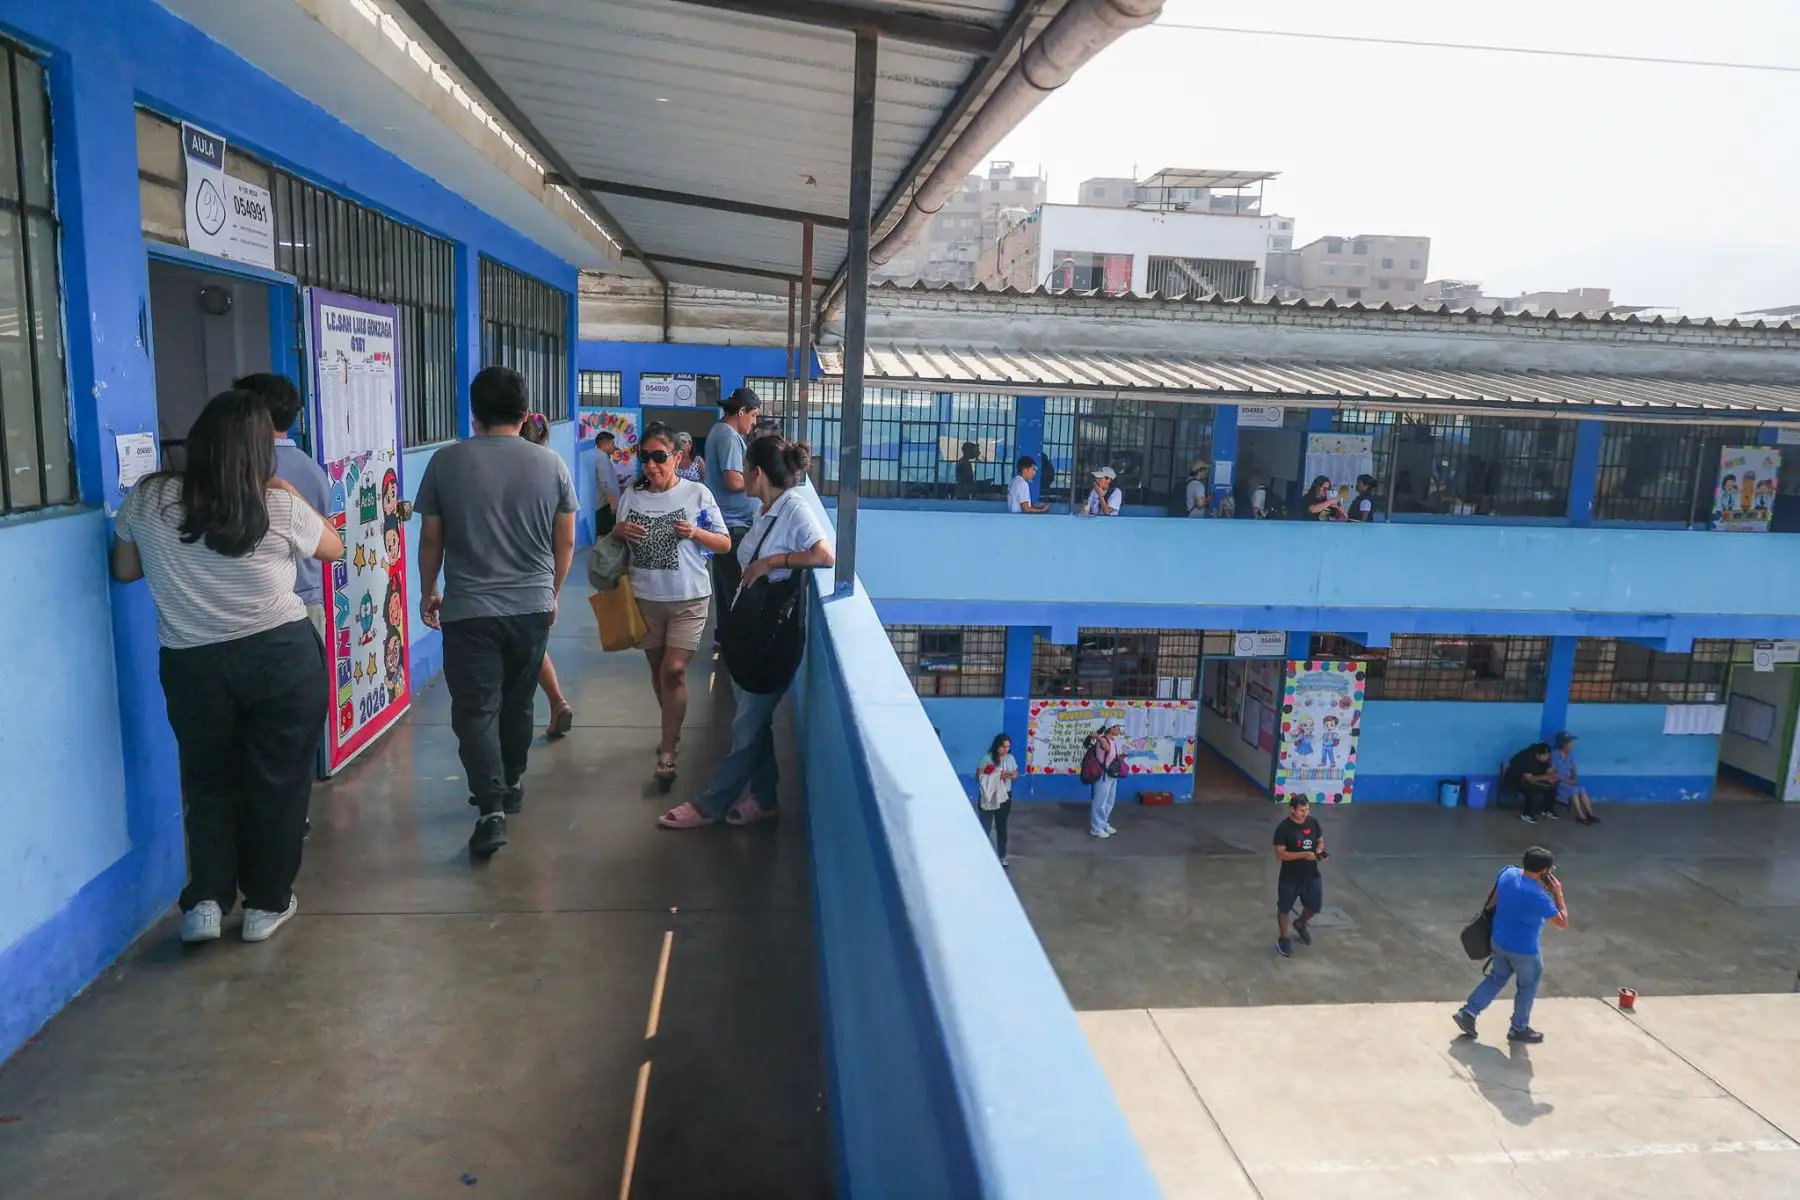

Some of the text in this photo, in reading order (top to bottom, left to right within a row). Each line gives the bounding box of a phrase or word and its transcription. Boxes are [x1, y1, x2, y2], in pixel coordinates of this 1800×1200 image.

[192, 134, 215, 159] AULA
[233, 195, 268, 224] 054991
[367, 319, 392, 339] GONZAGA
[359, 682, 386, 725] 2026
